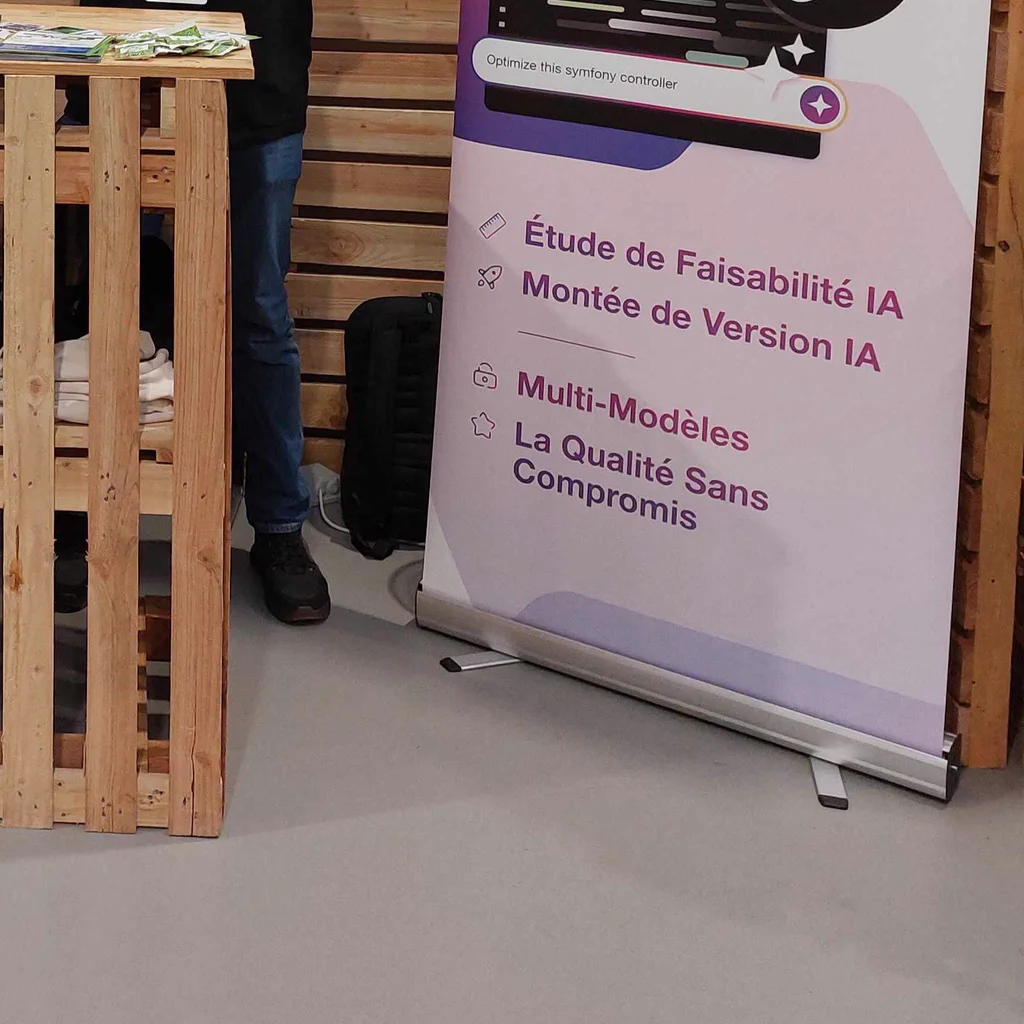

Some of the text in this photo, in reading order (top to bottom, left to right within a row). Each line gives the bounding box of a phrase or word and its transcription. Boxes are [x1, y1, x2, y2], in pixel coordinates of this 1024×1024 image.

[486, 52, 678, 90] Optimize this symfony controller
[526, 214, 903, 319] Étude de Faisabilité IA
[523, 271, 880, 372] Montée de Version IA
[517, 371, 749, 451] Multi-Modèles
[513, 458, 697, 530] Compromis
[516, 422, 769, 511] La Qualité Sans
